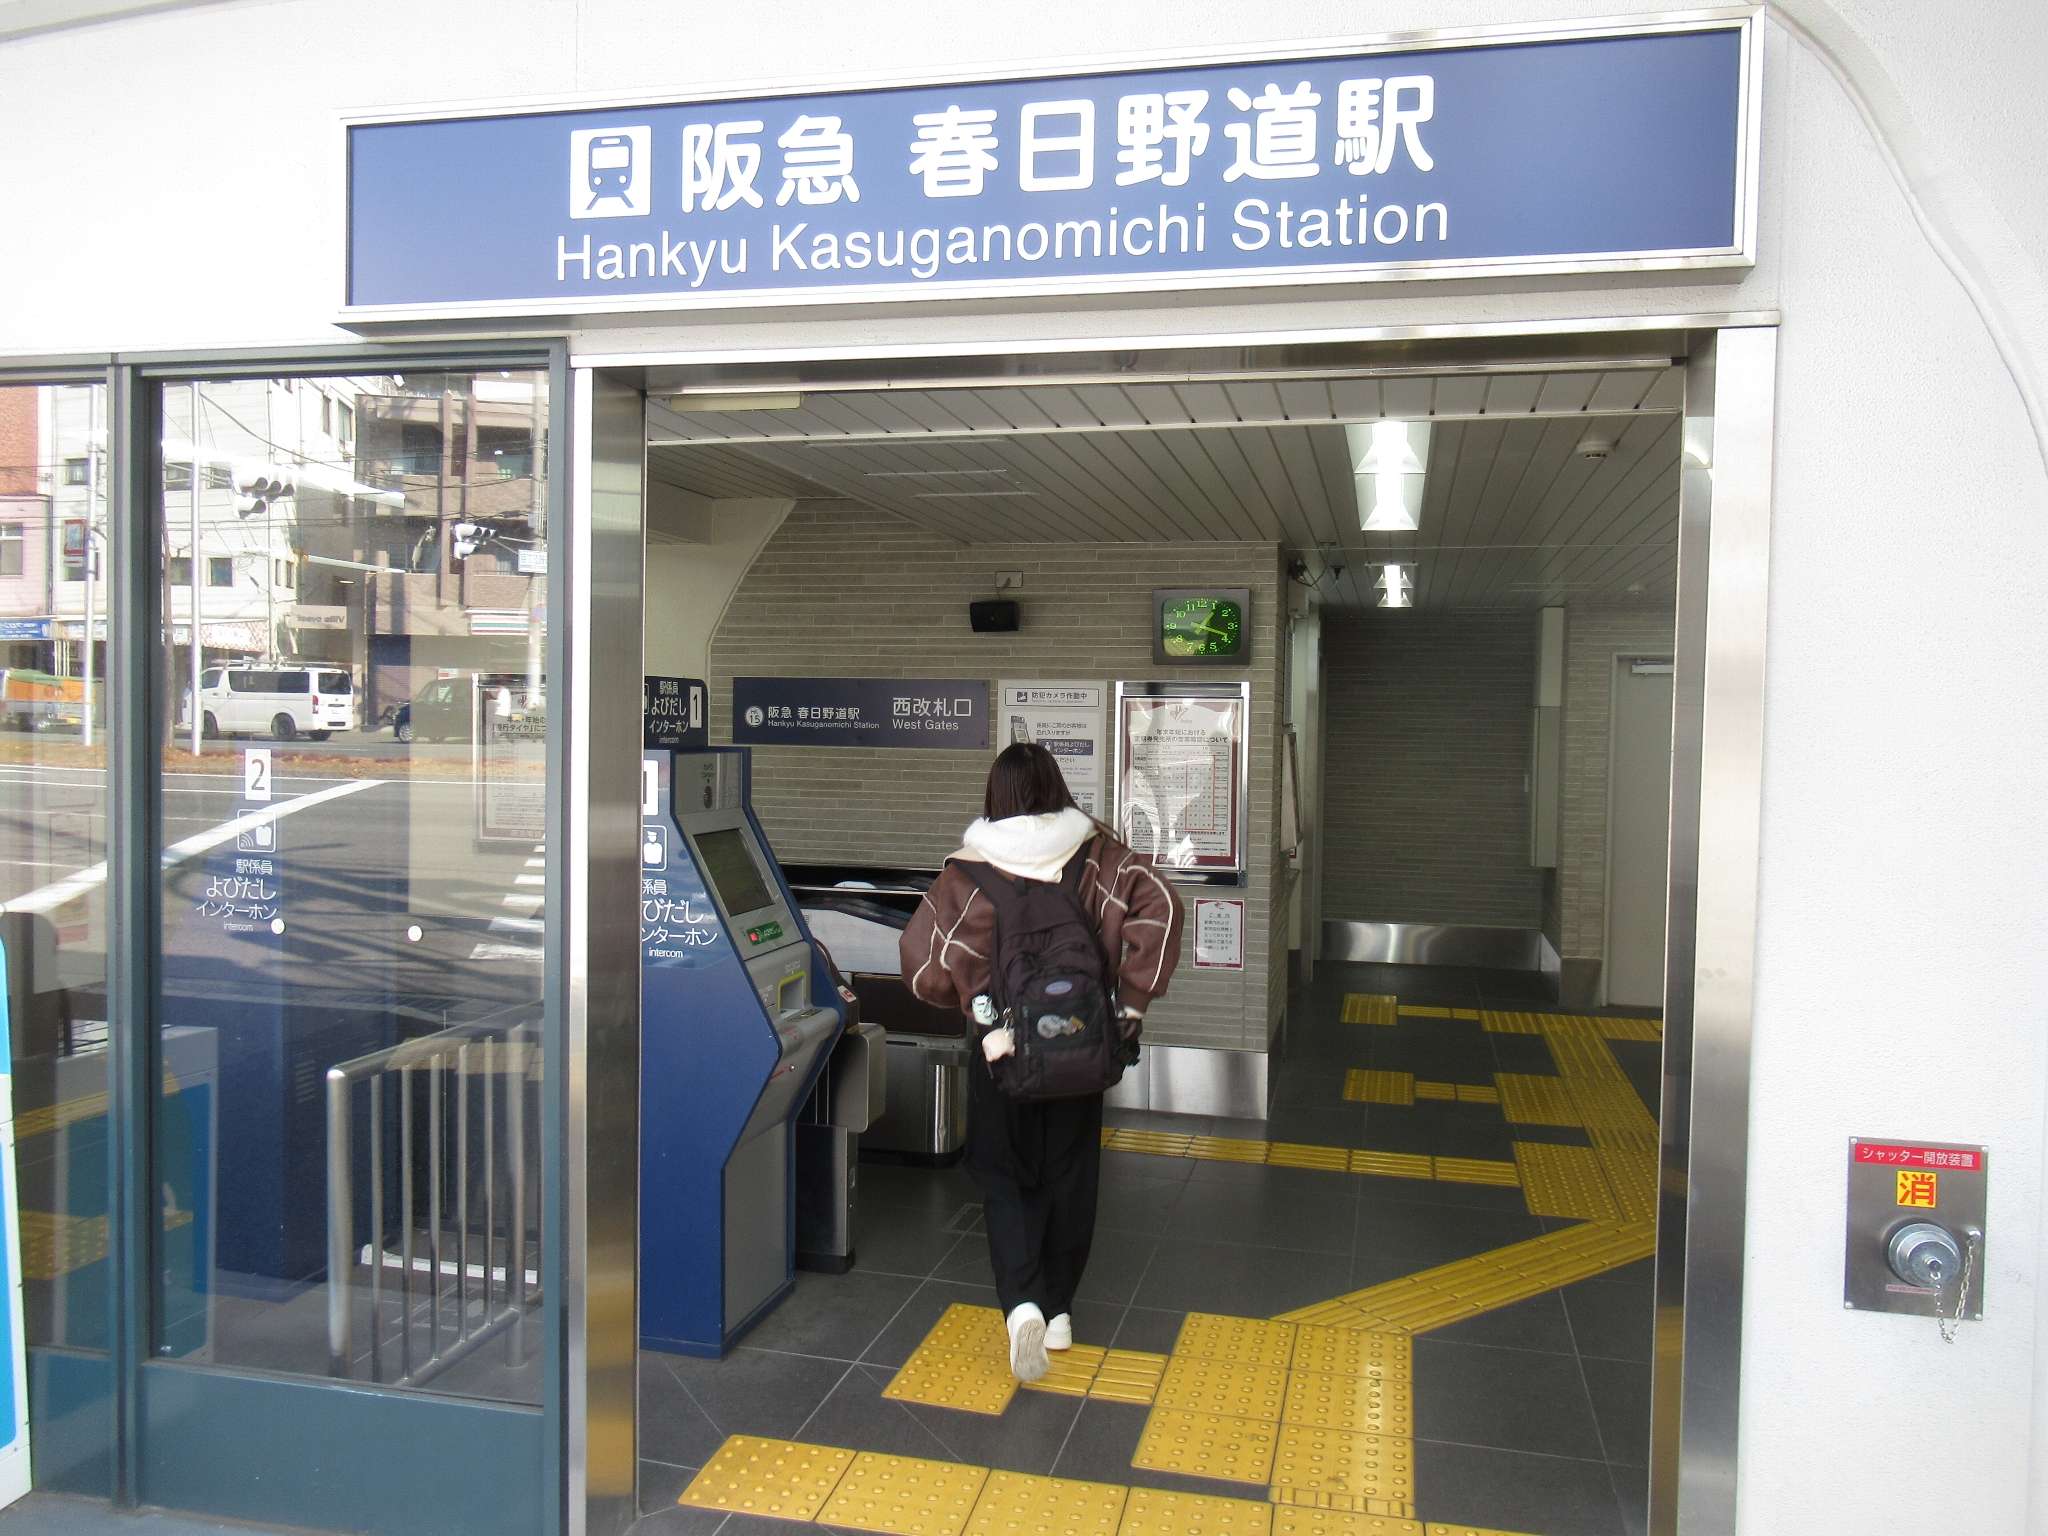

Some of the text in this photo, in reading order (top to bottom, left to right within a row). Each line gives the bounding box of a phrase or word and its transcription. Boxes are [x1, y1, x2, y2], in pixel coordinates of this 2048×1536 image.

[681, 75, 1435, 214] 阪急 春日野道駅
[556, 194, 1449, 288] Hankyu Kasuganomichi Station
[1186, 603, 1195, 611] 11
[1196, 600, 1208, 608] 12
[1211, 602, 1217, 610] 1
[1175, 610, 1186, 618] 10
[1221, 609, 1229, 617] 2
[1169, 622, 1177, 630] 9
[1227, 622, 1235, 630] 3
[1175, 634, 1183, 643] 8
[1186, 642, 1194, 650] 7
[1198, 643, 1206, 651] 6
[1209, 642, 1217, 650] 5
[651, 696, 687, 716] よびだし
[893, 697, 972, 717] 西改札口
[768, 706, 792, 719] 阪急
[797, 707, 860, 720] 春日野道駅
[649, 719, 689, 734] インターホン
[768, 720, 795, 728] Hankyu
[797, 721, 852, 730] Kasuganomichi
[892, 718, 959, 730] West Gates
[251, 758, 265, 791] 2
[235, 858, 273, 875] 駅係員
[206, 875, 277, 900] よびだし
[196, 900, 278, 921] インターホン
[648, 946, 684, 958] intercom
[1862, 1147, 1975, 1168] シャッター開放装置
[1899, 1173, 1936, 1207] 消
